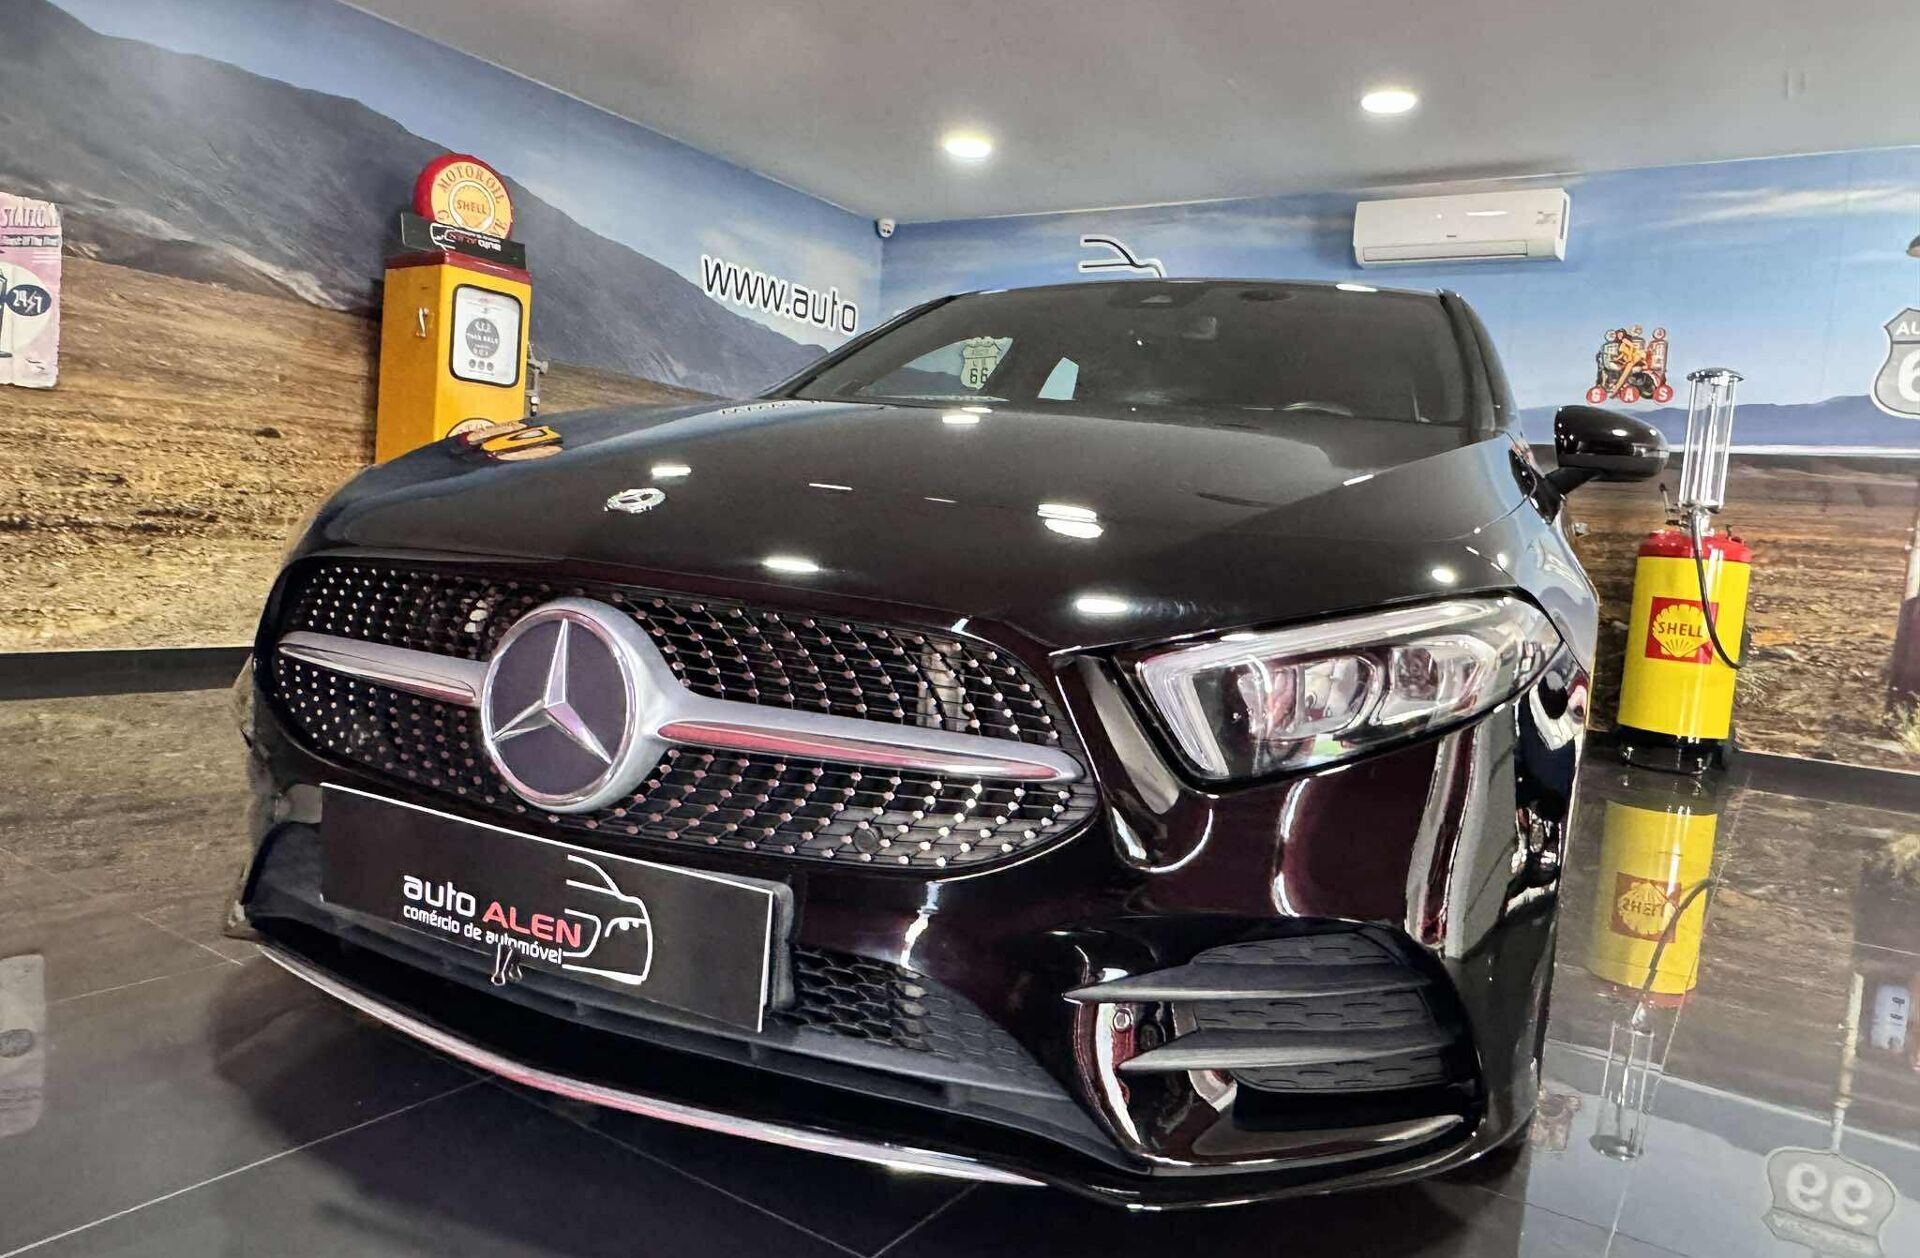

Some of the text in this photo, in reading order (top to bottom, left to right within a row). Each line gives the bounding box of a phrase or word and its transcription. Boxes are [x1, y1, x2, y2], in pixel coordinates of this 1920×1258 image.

[456, 200, 487, 215] SHELL
[703, 257, 857, 333] www.auto
[1657, 621, 1704, 638] SHELL
[403, 874, 582, 949] auto ALEN
[403, 905, 460, 934] comércio
[463, 921, 482, 942] de
